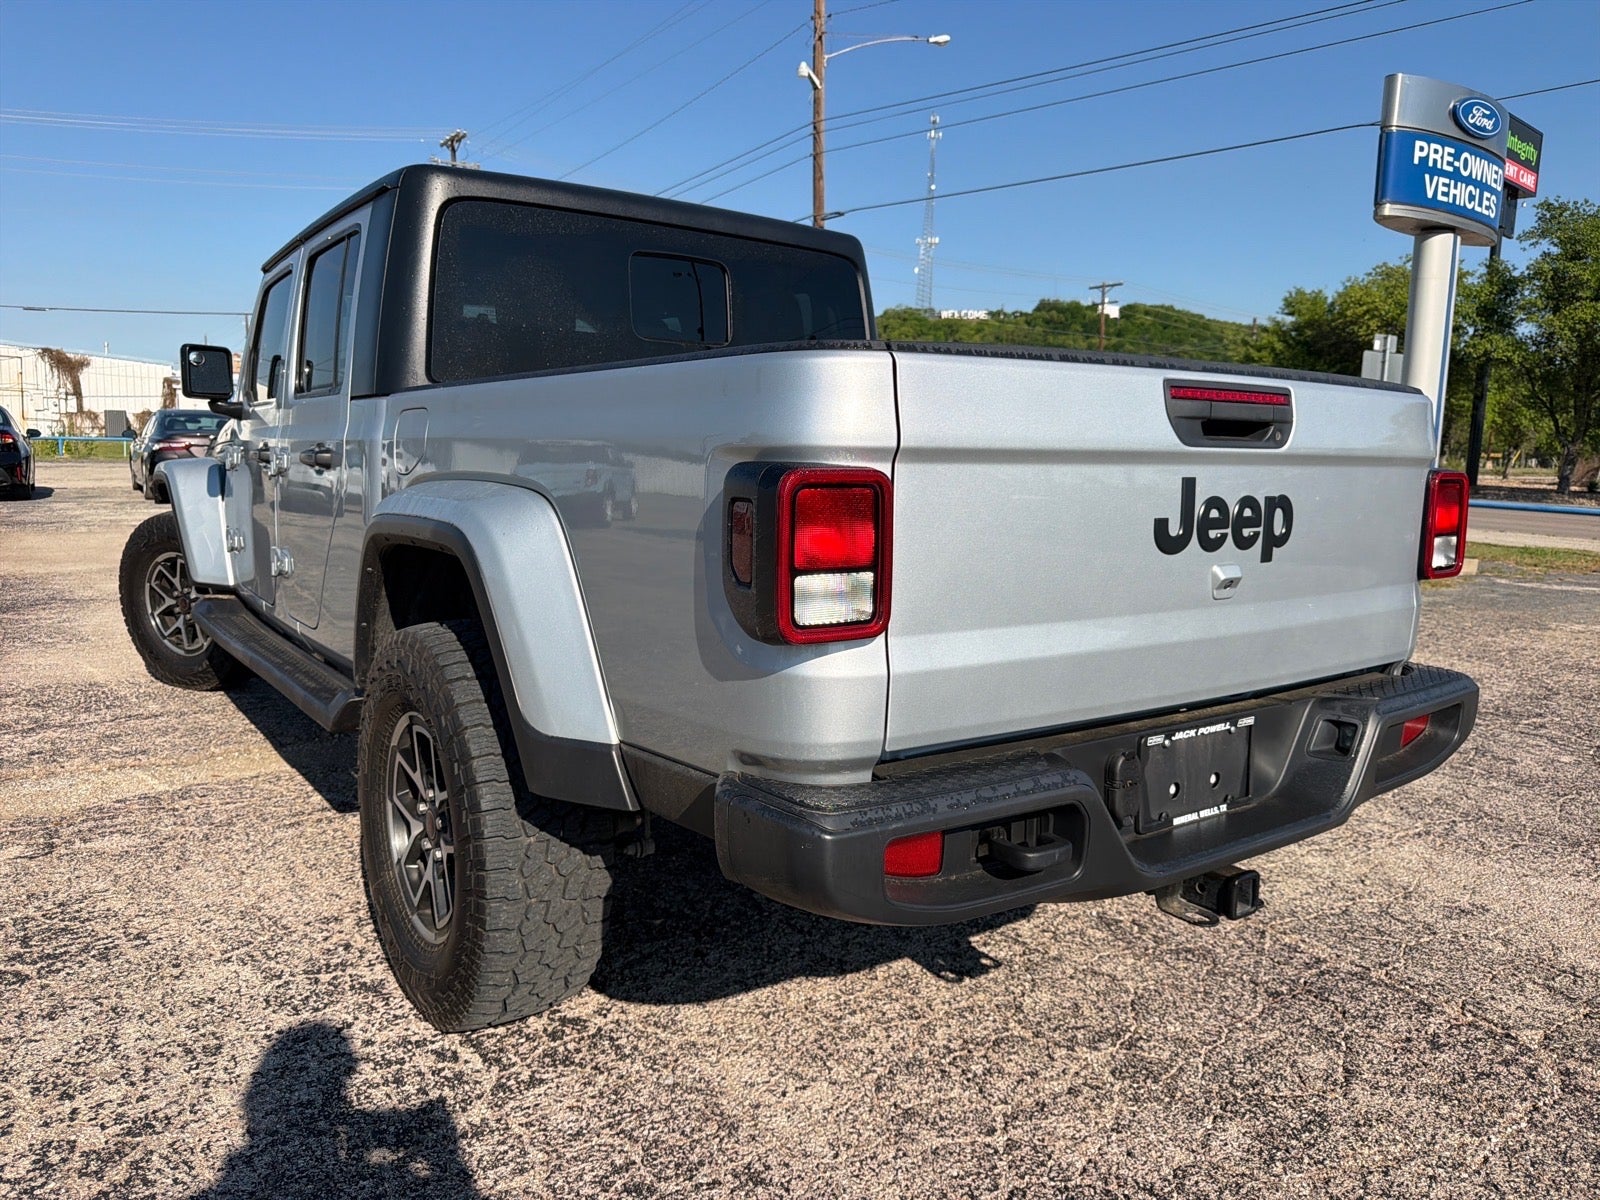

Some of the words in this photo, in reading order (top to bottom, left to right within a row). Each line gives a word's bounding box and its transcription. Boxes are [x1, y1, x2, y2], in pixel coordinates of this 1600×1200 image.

[1468, 105, 1496, 130] Ford
[1507, 130, 1538, 166] Integrity
[1413, 140, 1503, 192] PRE-OWNED
[1520, 169, 1536, 188] CARE
[1424, 173, 1497, 219] VEHICLES
[941, 310, 988, 319] WELCOME
[1153, 476, 1294, 563] Jeep
[1171, 728, 1197, 740] JACK
[1197, 722, 1231, 736] POWELL
